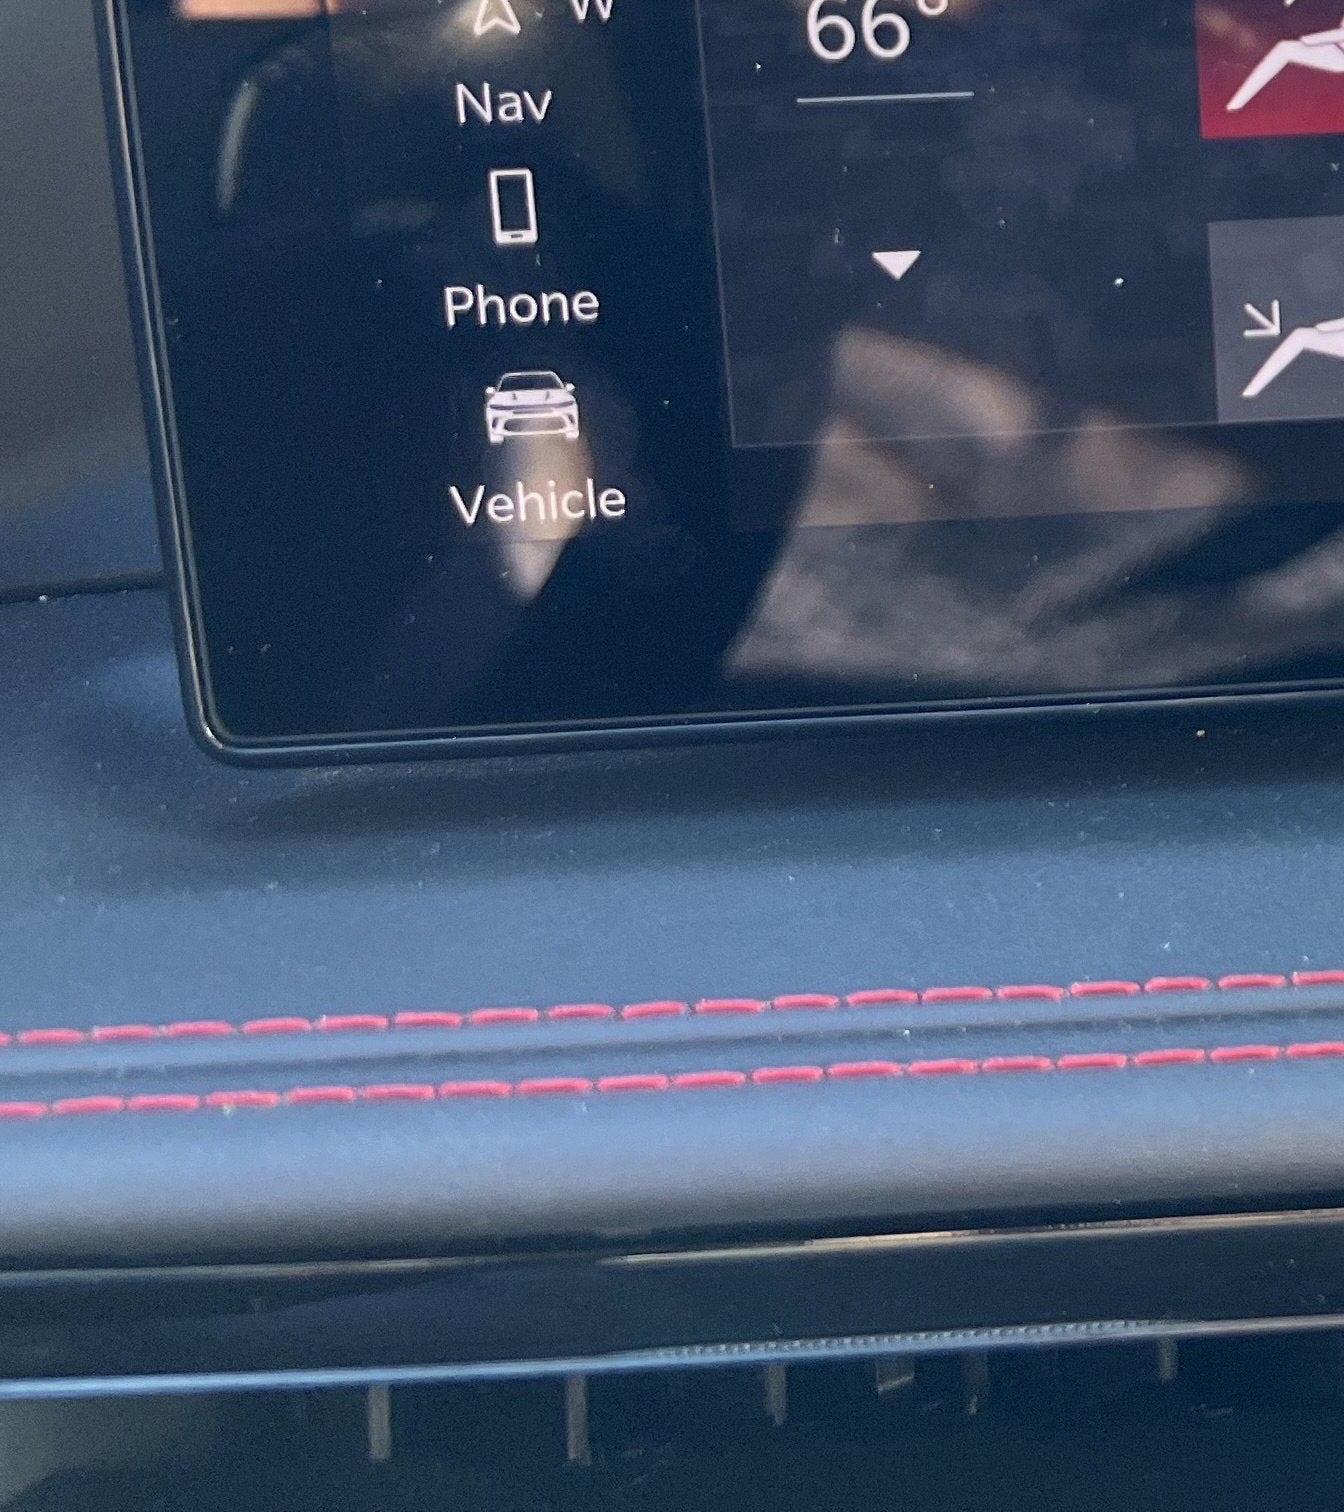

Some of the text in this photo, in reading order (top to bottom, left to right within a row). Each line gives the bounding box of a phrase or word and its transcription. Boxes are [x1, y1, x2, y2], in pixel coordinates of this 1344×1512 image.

[456, 83, 552, 125] Nav
[444, 286, 599, 328] Phone
[450, 478, 626, 524] Vehicle
